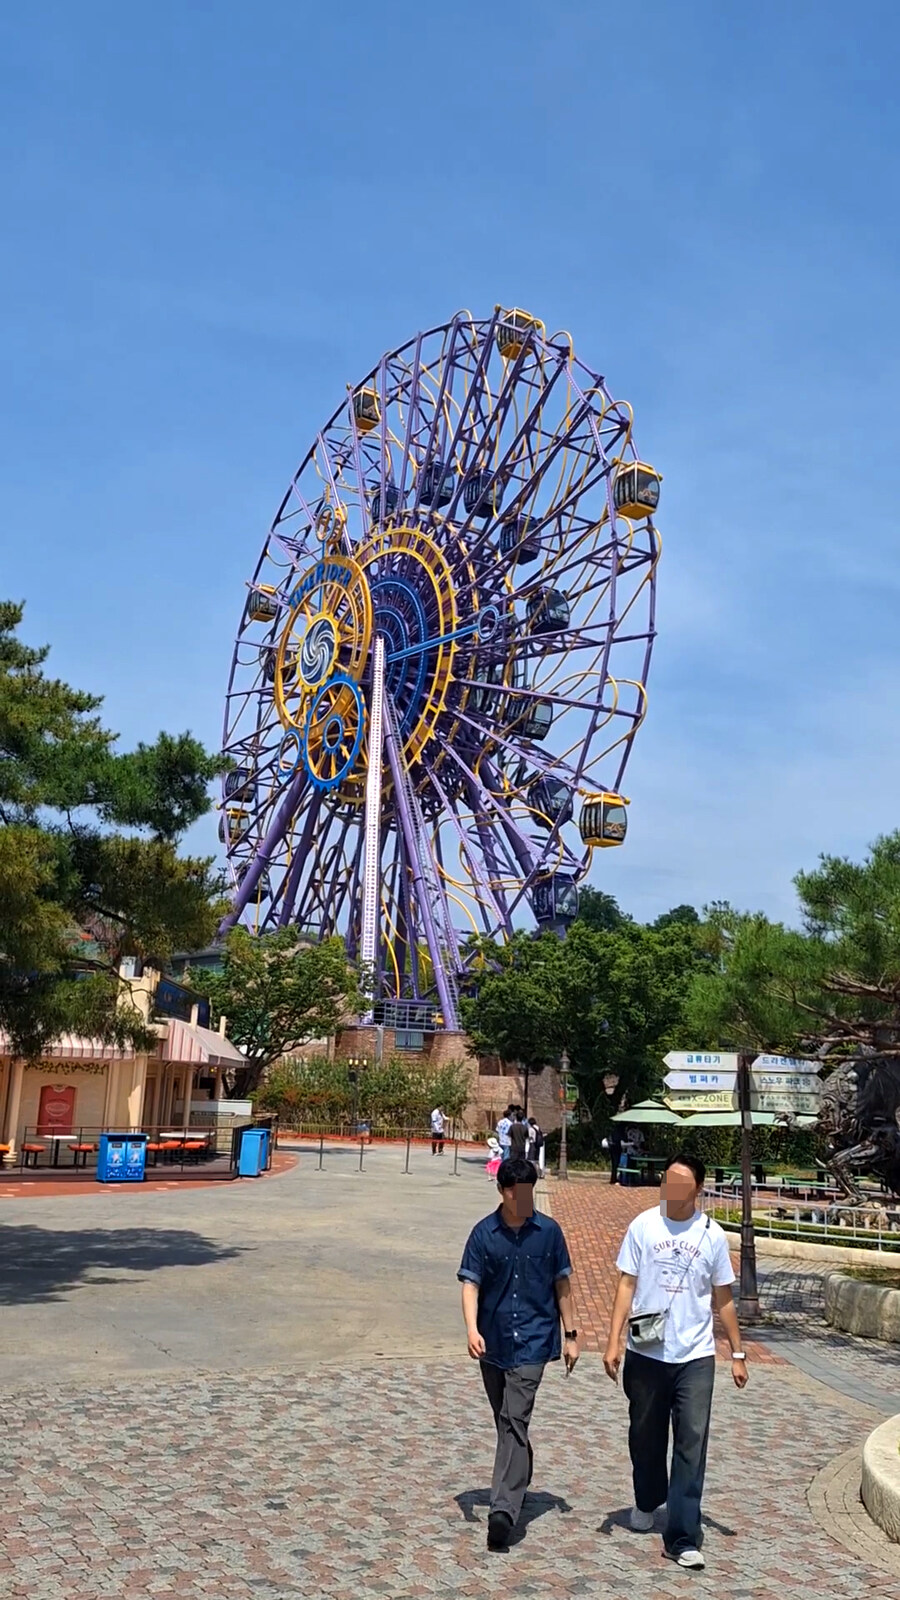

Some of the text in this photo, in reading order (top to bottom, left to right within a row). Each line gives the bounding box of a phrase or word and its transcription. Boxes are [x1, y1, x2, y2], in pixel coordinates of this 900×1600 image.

[315, 563, 352, 587] RIDER
[686, 1055, 721, 1064] 급류타기
[689, 1075, 719, 1084] 범퍼카
[691, 1094, 729, 1103] X-ZONE
[653, 1239, 702, 1258] SURF CLUB
